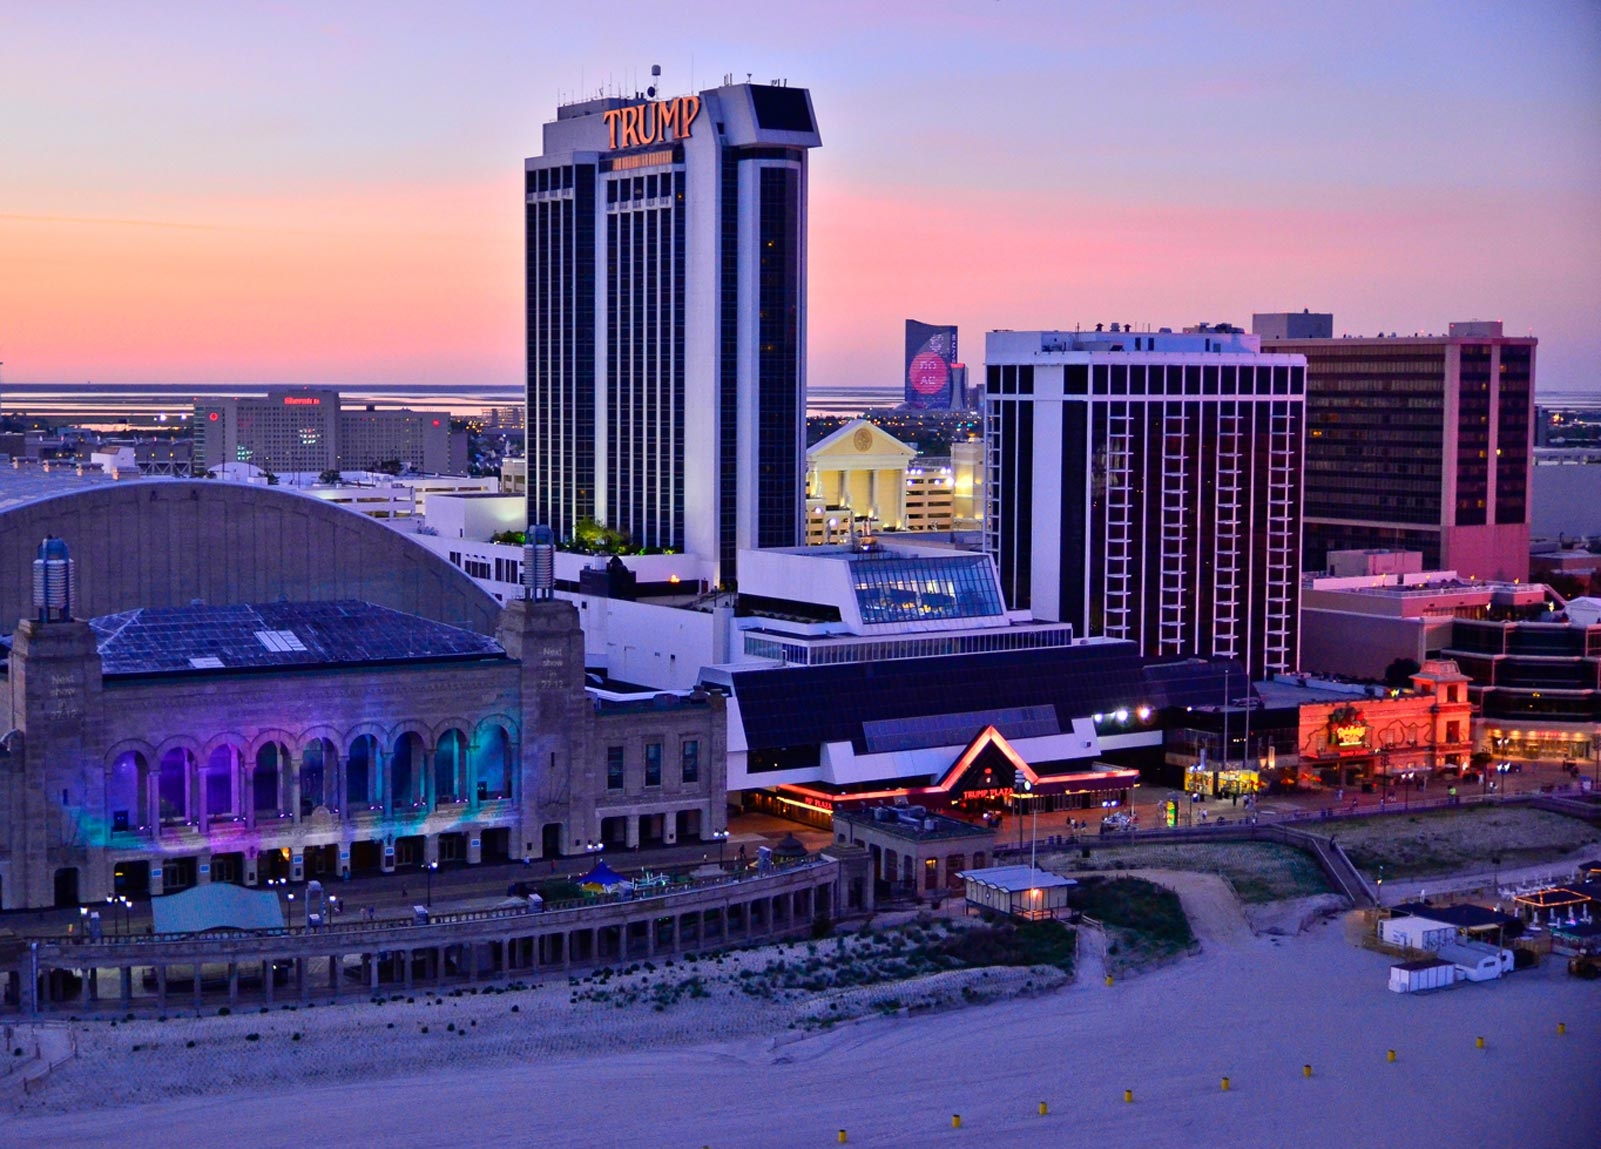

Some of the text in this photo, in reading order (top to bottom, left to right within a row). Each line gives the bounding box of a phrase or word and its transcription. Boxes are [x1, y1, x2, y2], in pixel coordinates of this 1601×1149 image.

[603, 96, 700, 150] TRUMP
[543, 647, 562, 656] Next
[963, 787, 1014, 800] TRUMP PLAZA
[814, 799, 833, 810] PLAZA
